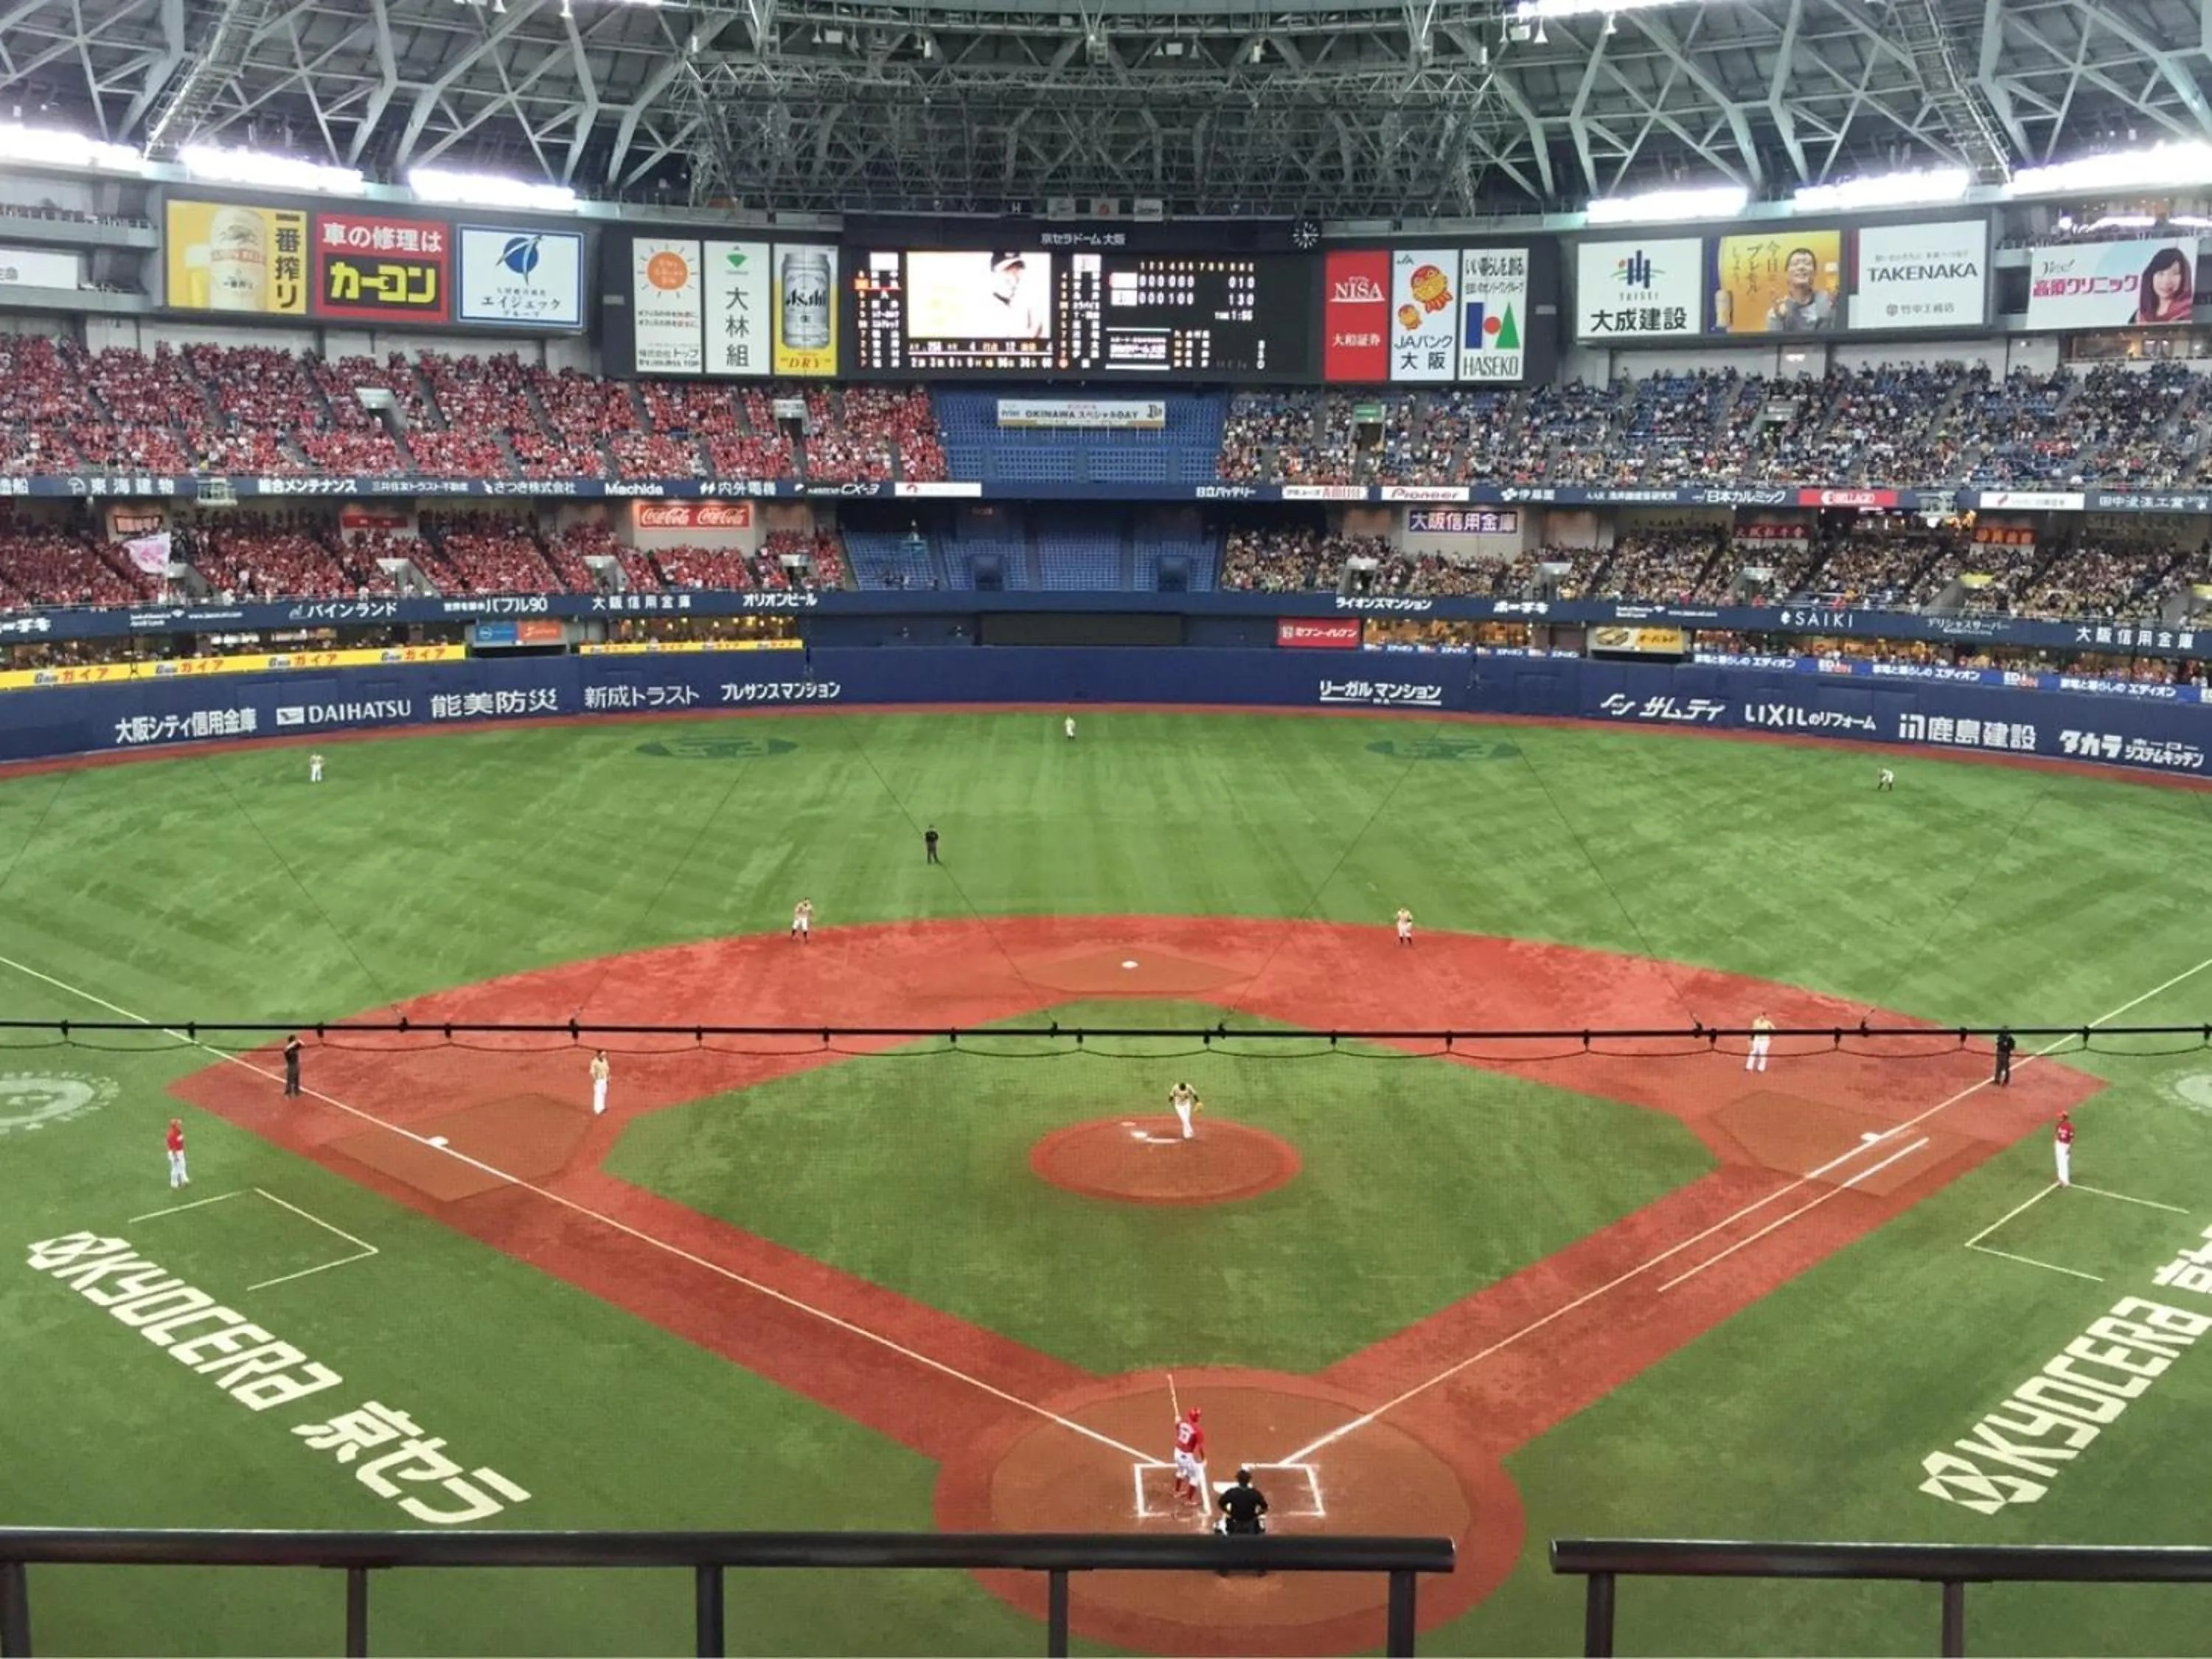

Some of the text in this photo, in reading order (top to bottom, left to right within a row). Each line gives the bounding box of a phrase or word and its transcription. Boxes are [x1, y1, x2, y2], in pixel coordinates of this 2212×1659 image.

[323, 222, 443, 252] 車の修理は
[274, 213, 302, 310] 一番搾り
[1867, 262, 1978, 282] TAKENAKA
[330, 261, 437, 304] カーコン
[1334, 282, 1384, 299] NISA
[2032, 273, 2141, 298] 高須クリニック
[481, 296, 561, 310] エイジェック
[785, 288, 827, 307] Asahi
[725, 287, 750, 368] 大林組
[1590, 306, 1688, 333] 大成建設
[1332, 332, 1381, 347] 大和証券
[1394, 335, 1454, 350] JAバンク
[787, 357, 820, 369] DRY
[1400, 352, 1446, 370] 大阪
[1463, 355, 1520, 377] HASEKO
[1026, 408, 1074, 419] OKINAWA
[258, 478, 358, 495] 総合メンテナンス
[372, 481, 469, 493] 三井住友トラスト不動産
[494, 479, 577, 495] さつき株式会社
[605, 480, 664, 495] Machida
[718, 481, 776, 495] 内外電機
[841, 483, 880, 495] CX-3
[1391, 487, 1461, 500] Pioneer
[1518, 489, 1556, 501] 伊藤園
[1705, 490, 1786, 504] 日本カルミック
[641, 507, 745, 526] Coca-Cola Coca-Cola
[1410, 512, 1517, 532] 大阪信用金庫
[592, 594, 692, 610] 大阪信用金庫
[742, 593, 818, 608] オリオンビール
[1335, 597, 1432, 610] ライオンズマンション
[1493, 601, 1550, 614] ホーチキ
[0, 618, 51, 633] ーチキ
[1795, 611, 1854, 628] SAIKI
[2076, 627, 2196, 650] 大阪信用金庫
[294, 653, 338, 667] ガイア
[405, 648, 446, 661] ガイア
[1752, 656, 1797, 670] エディオン
[181, 659, 224, 672] ガイア
[63, 668, 109, 684] ガイア
[1935, 667, 1980, 682] エディオン
[583, 684, 700, 709] 新成トラスト
[720, 681, 841, 702] プレサンスマンション
[1319, 680, 1442, 698] リーガルマンション
[2127, 683, 2177, 698] エディオン
[308, 699, 411, 723] DAIHATSU
[430, 687, 560, 718] 能美防災
[1638, 695, 1727, 721] サムティ
[114, 707, 257, 744] 大阪シティ信用金庫
[1744, 703, 1877, 731] LIXILのリフォーム
[1927, 715, 2037, 751] 鹿島建設
[2059, 728, 2123, 759] タカラ
[2132, 738, 2199, 753] ホーロー
[2124, 745, 2205, 769] システムキッチン
[290, 1401, 532, 1525] 京セラ
